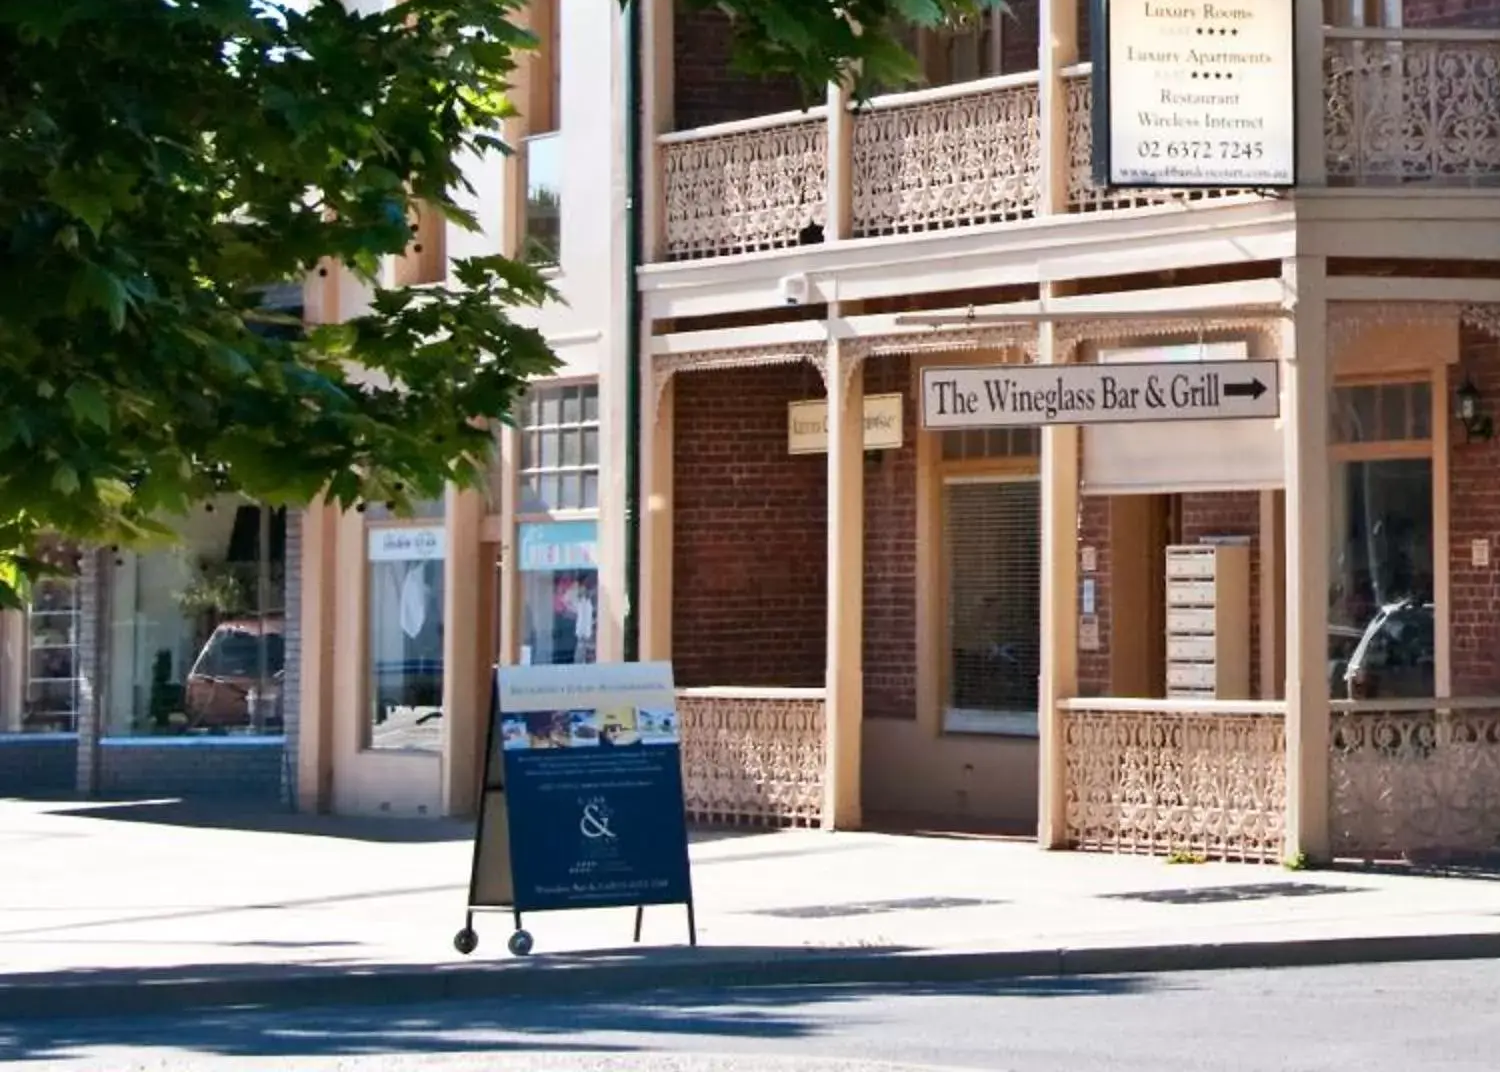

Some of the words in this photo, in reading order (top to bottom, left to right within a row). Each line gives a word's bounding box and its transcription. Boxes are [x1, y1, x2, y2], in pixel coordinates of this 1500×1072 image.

[1145, 1, 1196, 18] Luxury
[1203, 3, 1254, 19] Rooms
[1127, 45, 1179, 63] Luxury
[1186, 48, 1272, 66] Apartments
[1160, 88, 1240, 105] Restaurant
[1138, 109, 1200, 127] Wireless
[1204, 112, 1264, 129] Internet
[1138, 140, 1161, 158] 02
[1167, 140, 1212, 159] 6372
[1218, 140, 1264, 160] 7245
[932, 380, 978, 415] The
[984, 378, 1096, 419] Wineglass
[1101, 375, 1139, 410] Bar
[1144, 375, 1167, 408] &
[1171, 373, 1220, 408] Grill
[579, 804, 617, 838] &
